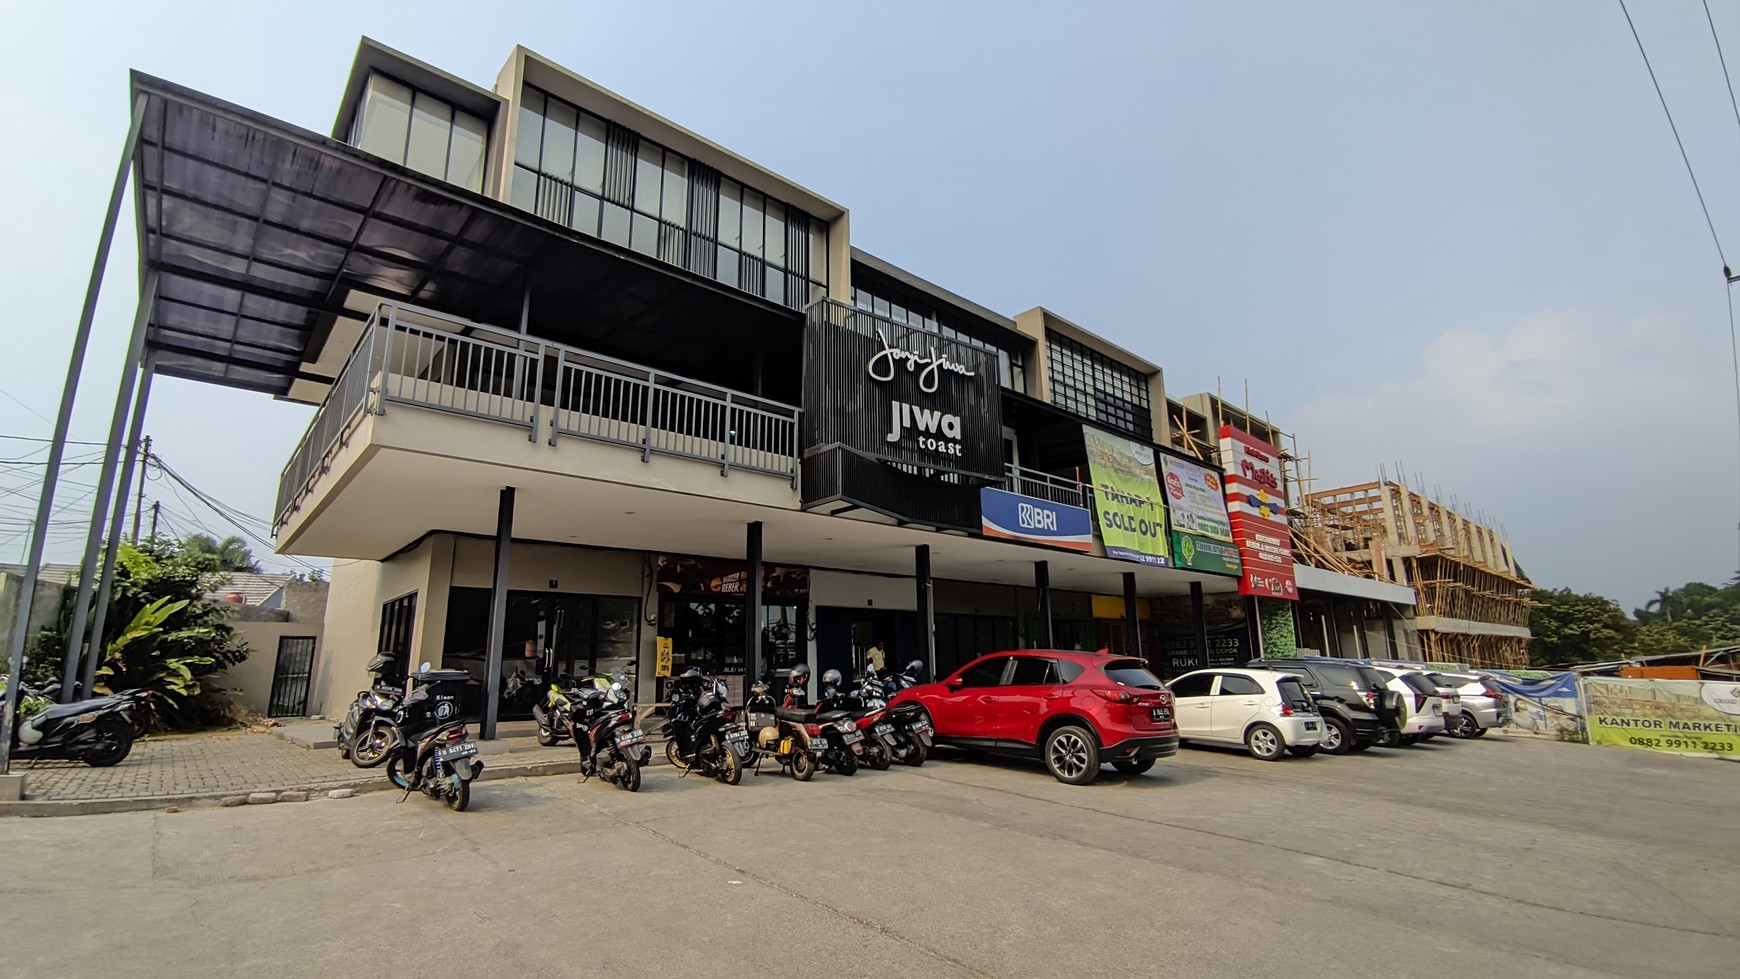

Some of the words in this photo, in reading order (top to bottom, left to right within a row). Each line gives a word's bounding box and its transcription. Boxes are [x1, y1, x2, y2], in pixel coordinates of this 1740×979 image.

[918, 435, 962, 457] toast
[1100, 483, 1145, 508] TAHAP
[1033, 507, 1057, 531] BRI
[1103, 510, 1136, 533] SOLD
[1215, 638, 1240, 647] 2233
[1598, 716, 1663, 729] KANTOR
[1629, 736, 1661, 747] 0882
[1666, 739, 1697, 749] 9911
[1701, 741, 1734, 751] 2233
